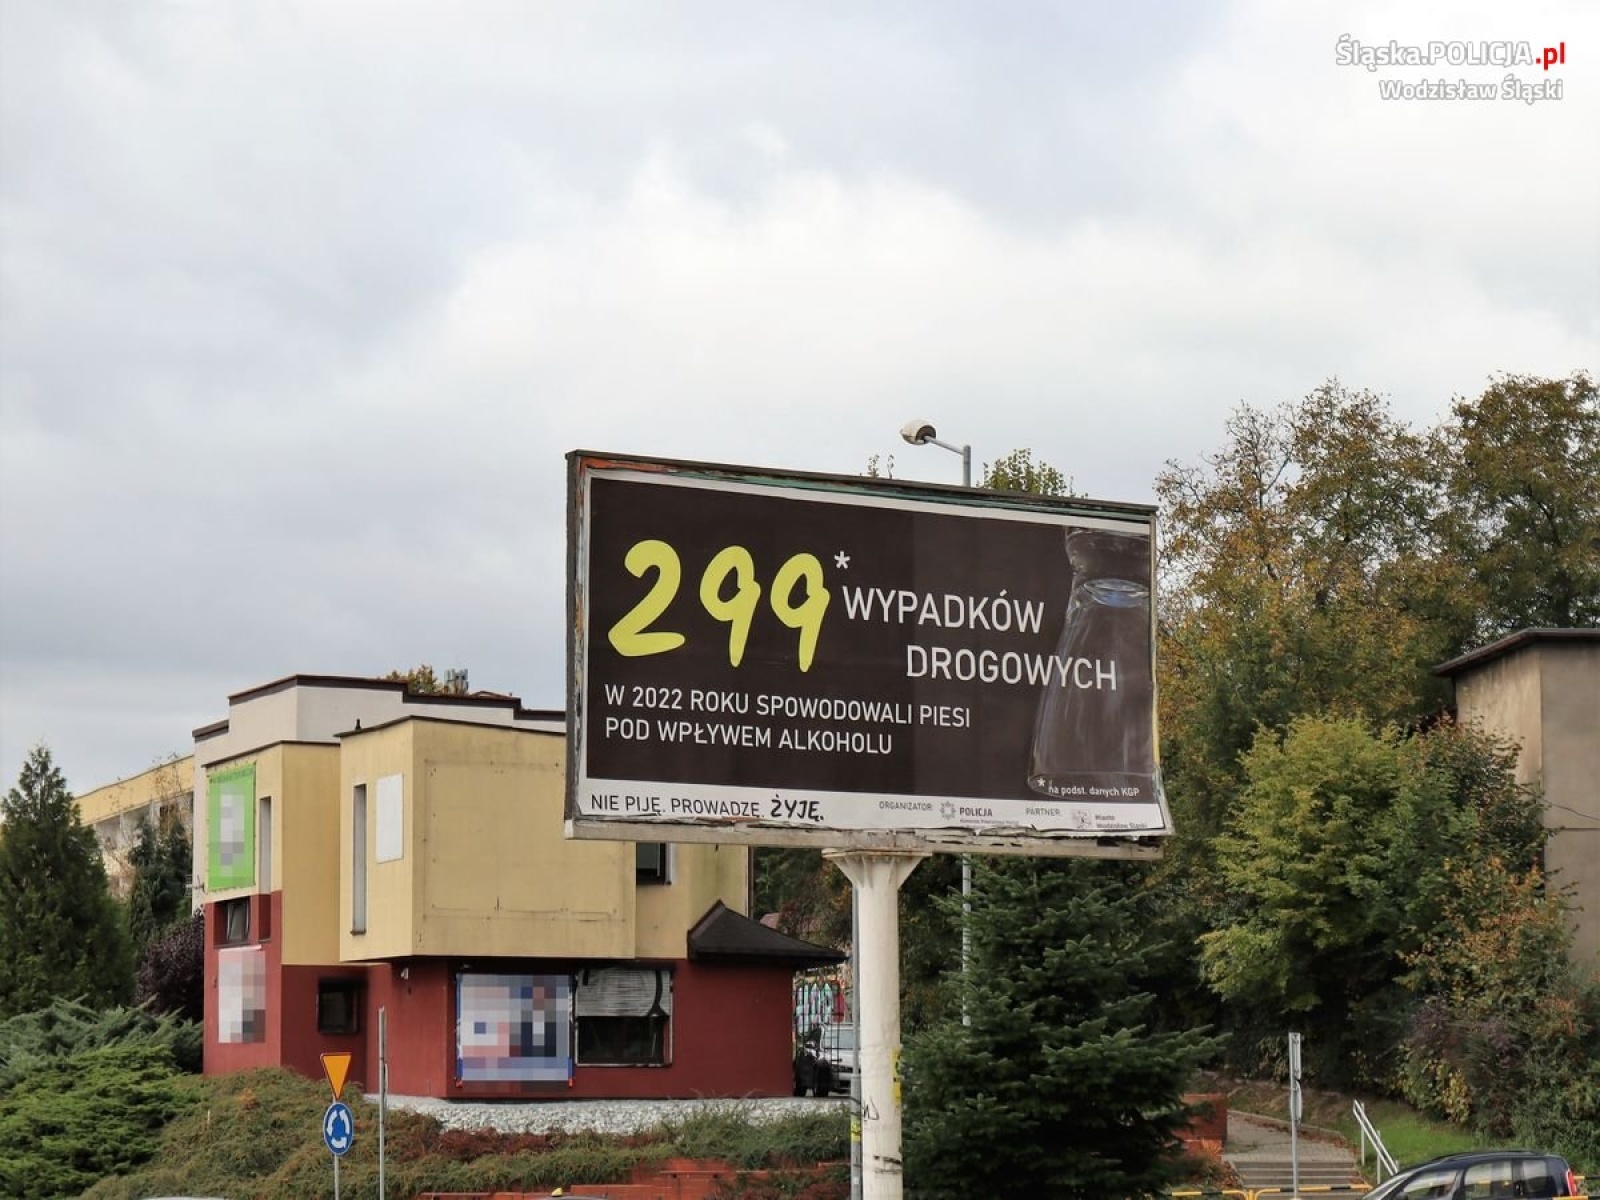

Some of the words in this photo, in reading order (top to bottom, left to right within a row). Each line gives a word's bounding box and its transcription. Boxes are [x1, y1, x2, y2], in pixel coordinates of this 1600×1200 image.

[842, 585, 1045, 634] WYPADKÓW
[906, 644, 1118, 691] DROGOWYCH
[604, 683, 625, 706] W
[632, 685, 683, 711] 2022
[690, 689, 749, 714] ROKU
[756, 694, 913, 725] SPOWODOWALI
[919, 704, 971, 728] PIESI
[605, 716, 650, 741] POD
[656, 719, 772, 749] WPŁYWEM
[778, 727, 893, 755] ALKOHOLU
[591, 794, 620, 811] NIE
[770, 793, 825, 822] ŻYJĘ.
[1088, 786, 1120, 798] danych
[1120, 787, 1140, 797] KGP
[959, 807, 993, 817] POLICJA
